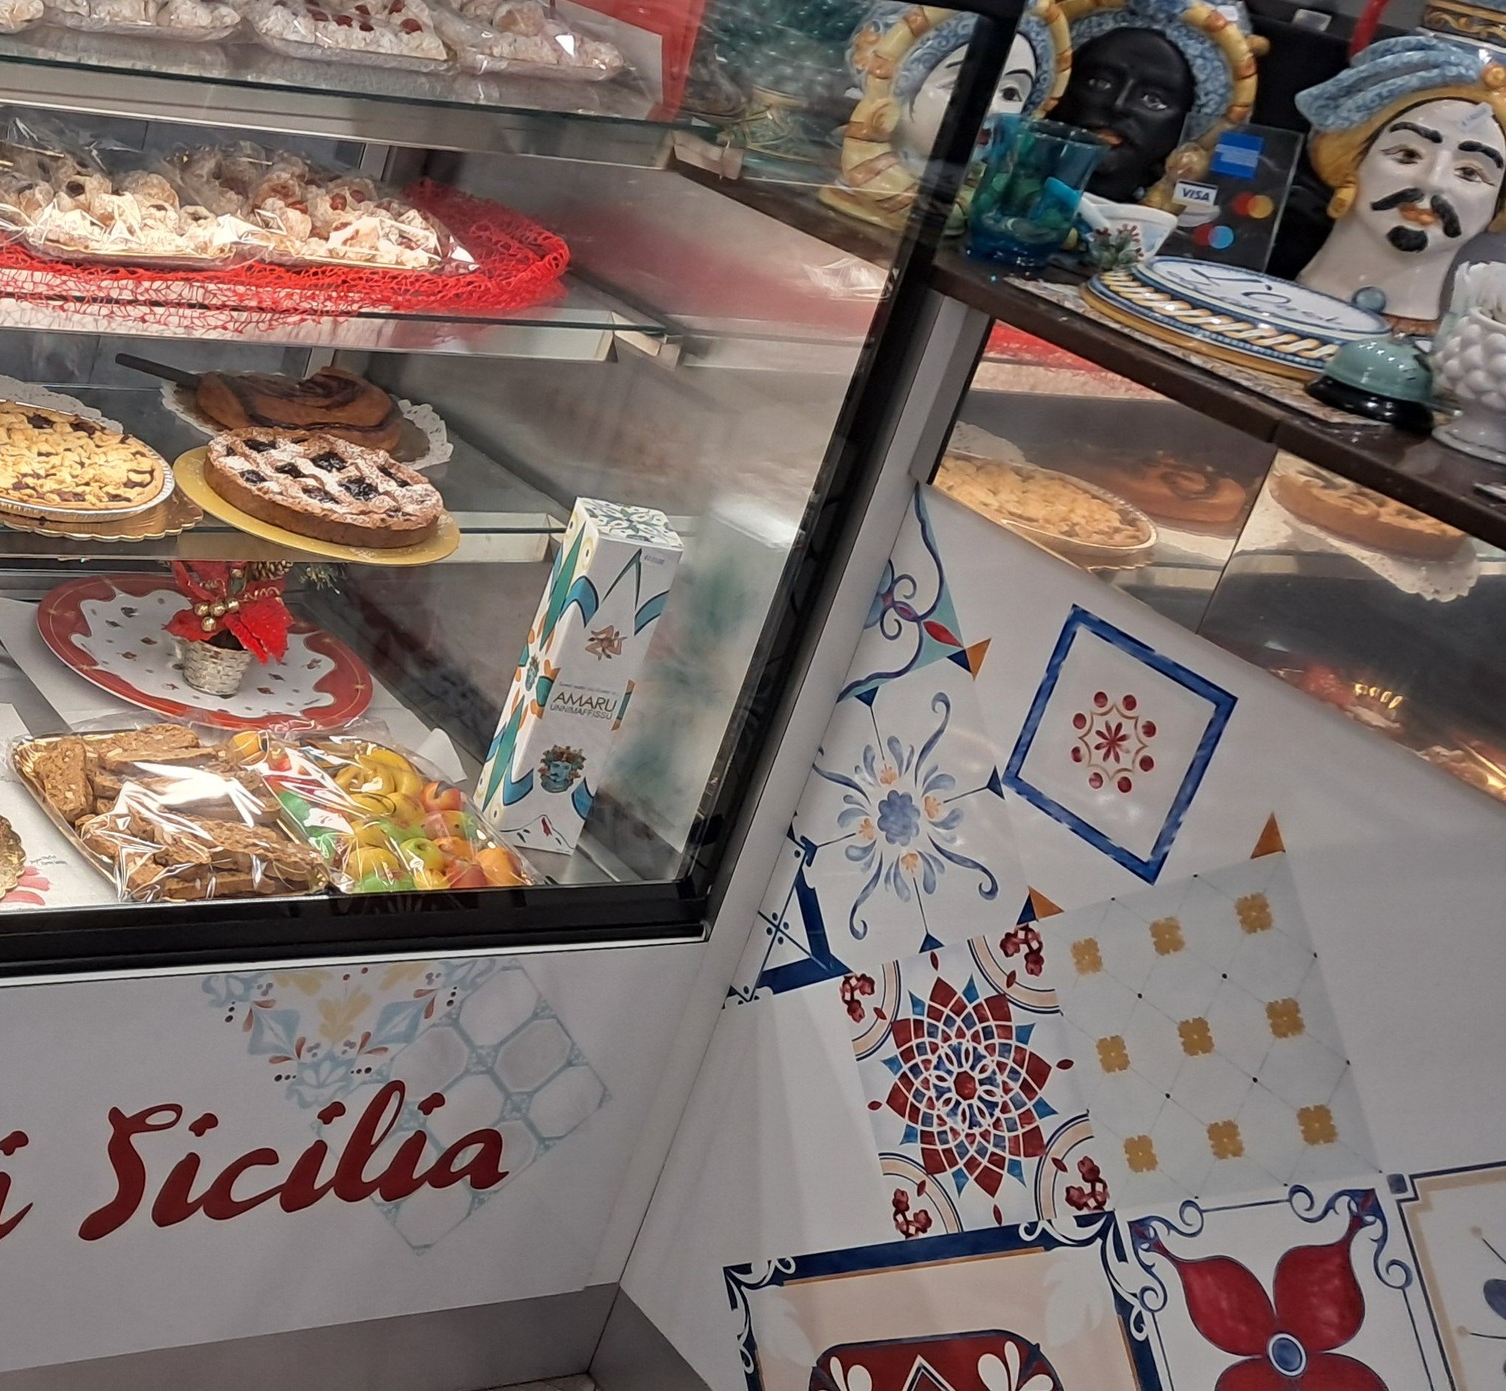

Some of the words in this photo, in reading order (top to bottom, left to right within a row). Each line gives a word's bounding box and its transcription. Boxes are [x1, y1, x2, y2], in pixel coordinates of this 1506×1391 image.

[1183, 188, 1210, 202] VISA
[553, 691, 618, 713] AMARU
[78, 1079, 511, 1242] Sicilia
